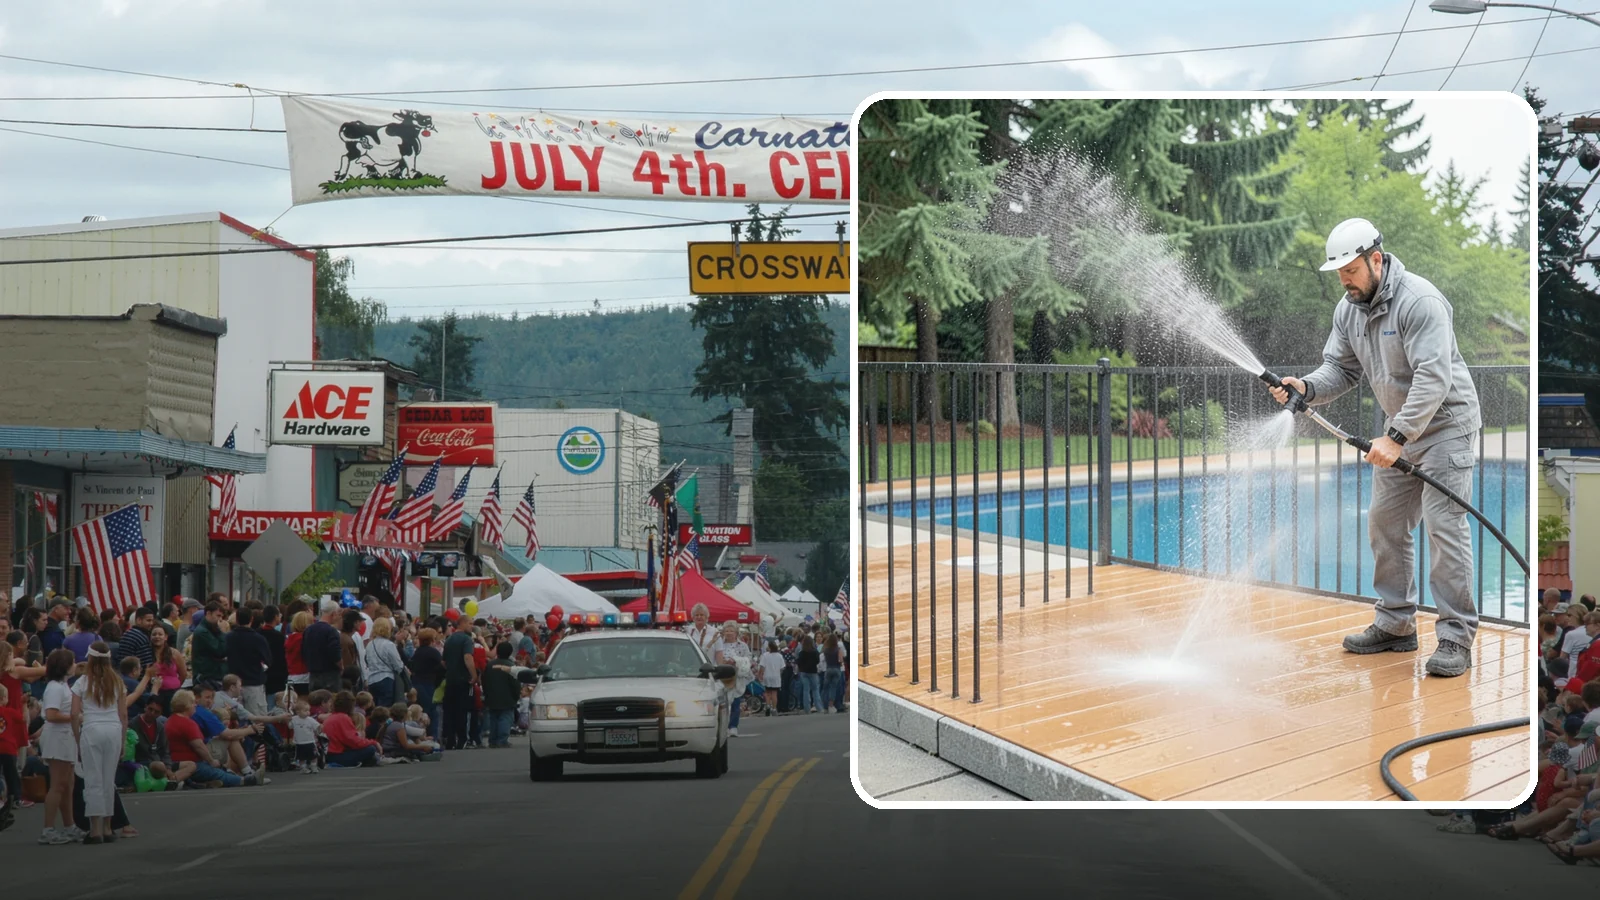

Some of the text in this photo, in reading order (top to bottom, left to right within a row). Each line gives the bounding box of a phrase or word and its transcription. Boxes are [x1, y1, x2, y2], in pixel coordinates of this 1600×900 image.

[481, 141, 605, 192] JULY
[632, 150, 746, 197] 4th.
[697, 254, 850, 280] CROSSWA
[283, 380, 373, 420] ACE
[406, 409, 453, 422] CEDAR
[284, 421, 370, 436] Hardware
[95, 485, 124, 495] Vincent
[126, 486, 136, 495] de
[137, 486, 155, 495] Paul
[688, 526, 741, 535] CRNATION
